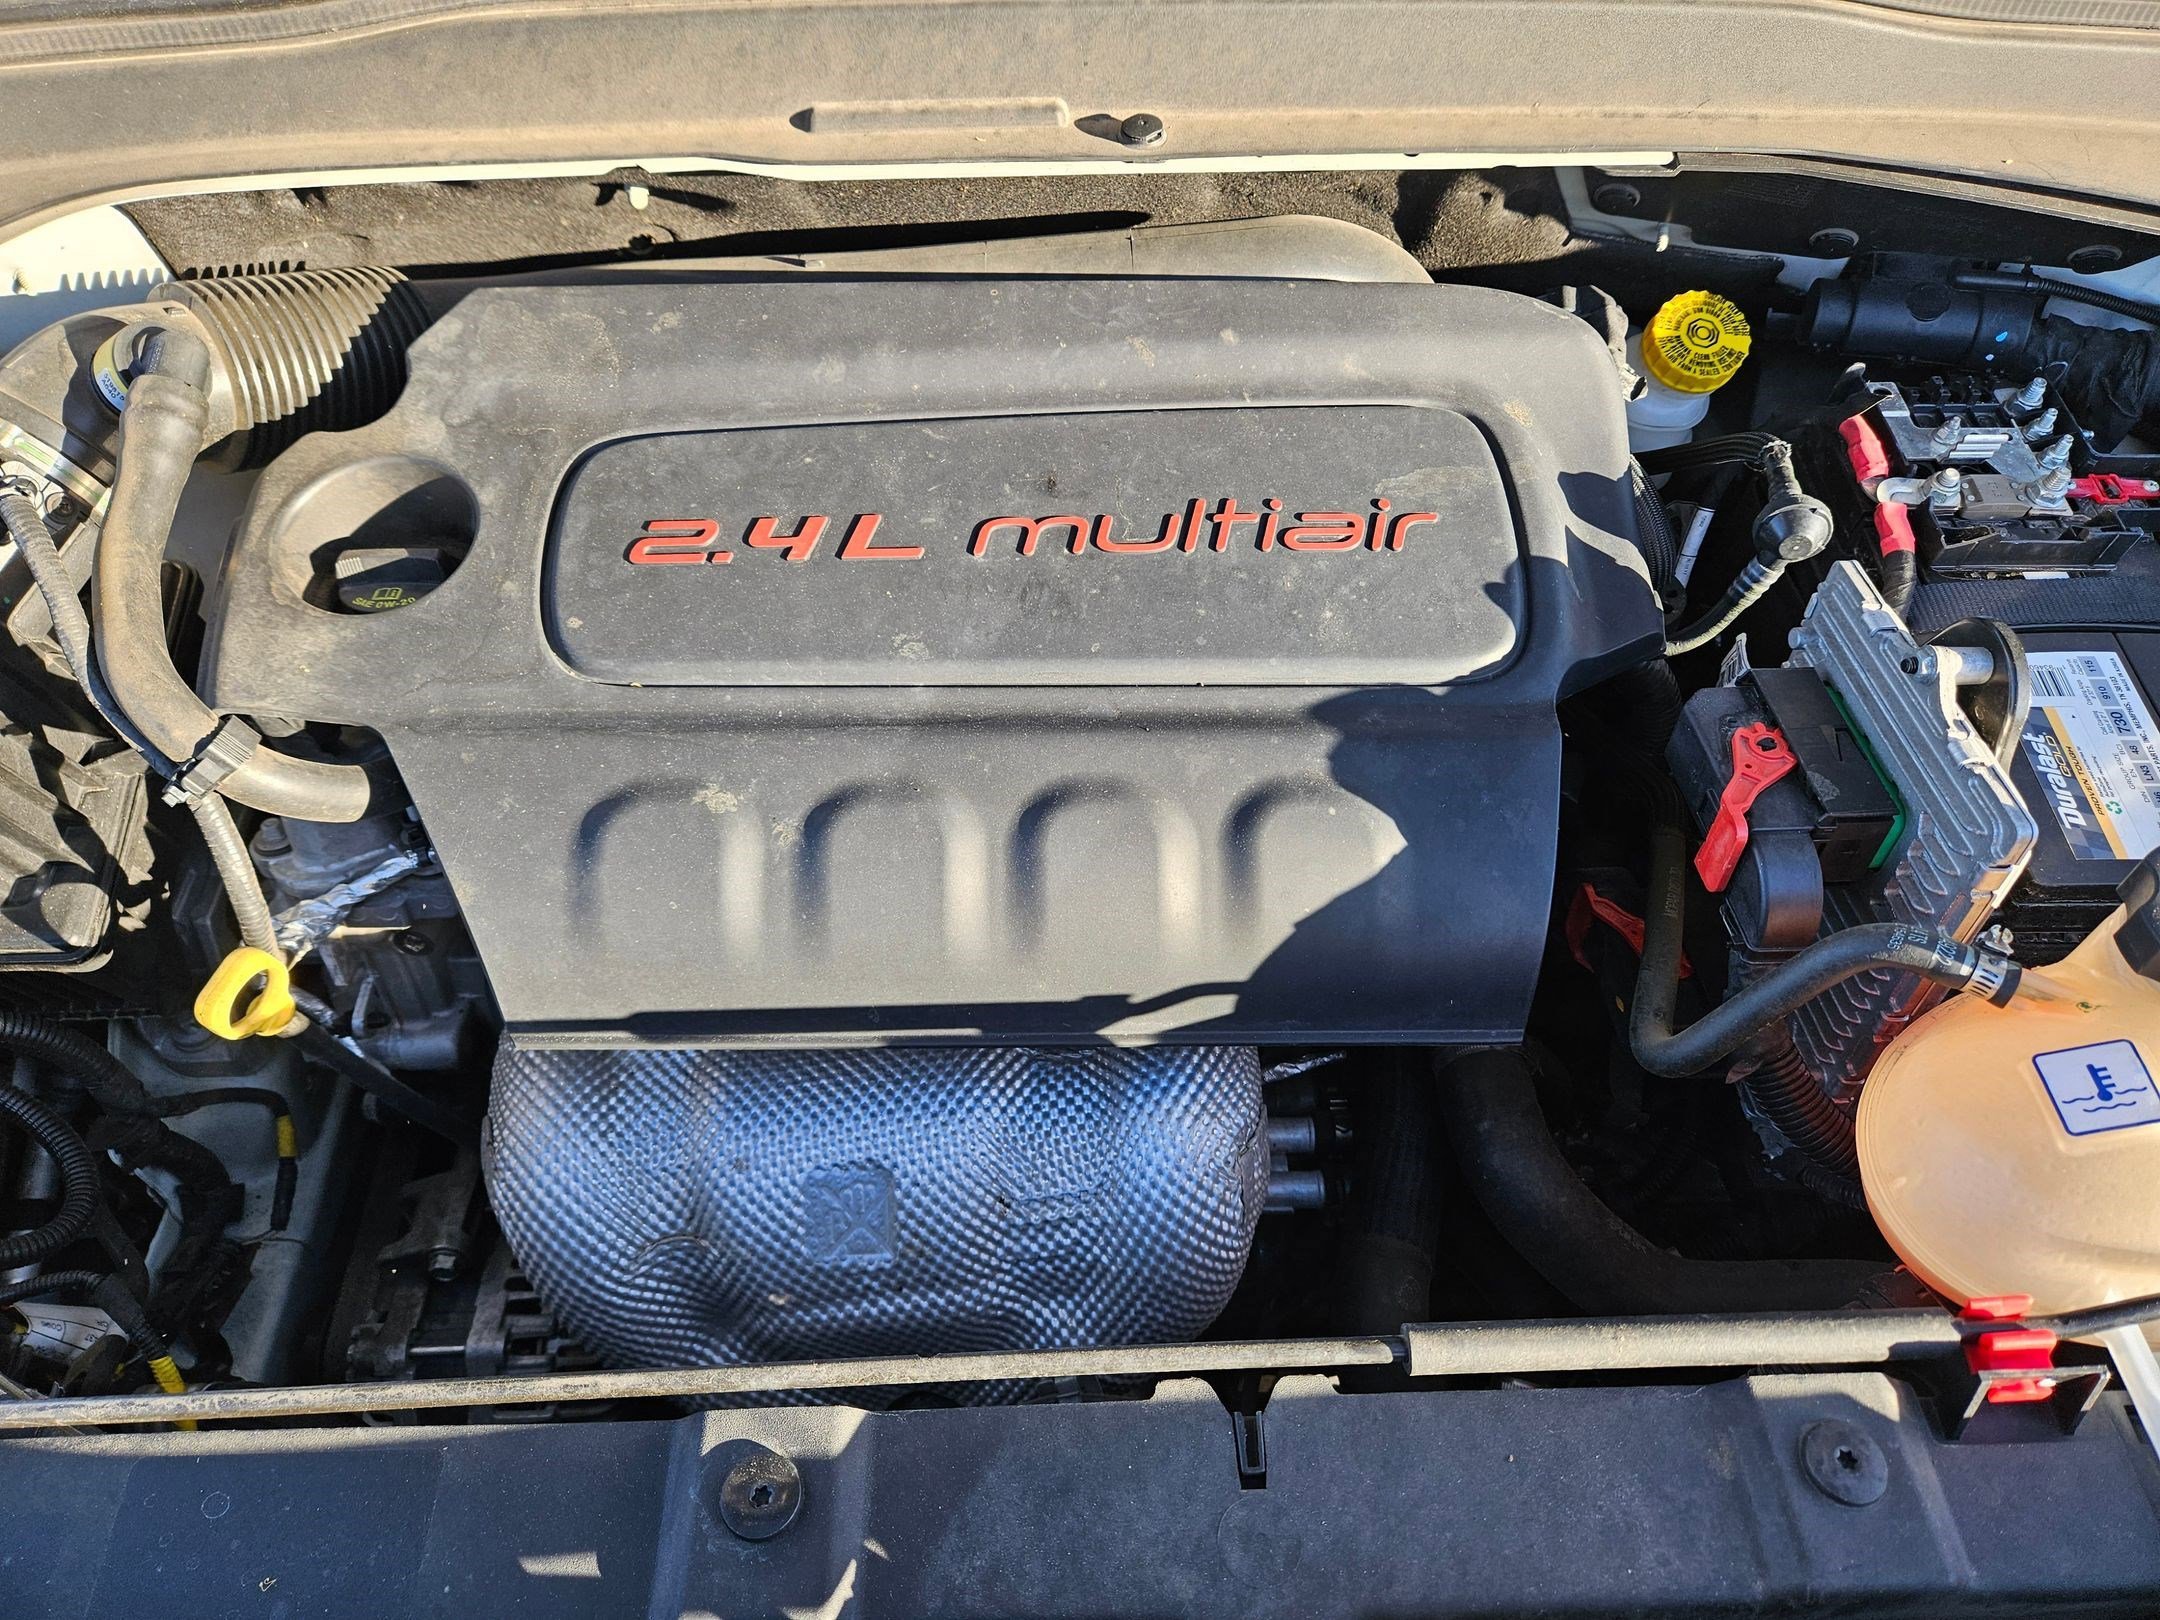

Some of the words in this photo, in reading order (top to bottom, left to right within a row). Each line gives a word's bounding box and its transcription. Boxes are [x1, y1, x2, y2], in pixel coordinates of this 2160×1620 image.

[969, 498, 1438, 557] multiair
[352, 597, 376, 608] SAE
[2084, 660, 2097, 672] 115
[2097, 686, 2111, 700] 910
[2110, 711, 2131, 733] 730
[2045, 735, 2072, 777] GOLD
[2129, 744, 2140, 755] 48
[2065, 745, 2085, 775] TOUGH
[2113, 753, 2123, 765] SIZE
[2121, 767, 2136, 789] GROUP
[2129, 768, 2137, 778] EN
[2139, 765, 2154, 780] LN3
[2022, 732, 2087, 830] Duralast
[2082, 778, 2105, 816] PROVEN
[2140, 791, 2151, 803] DIN
